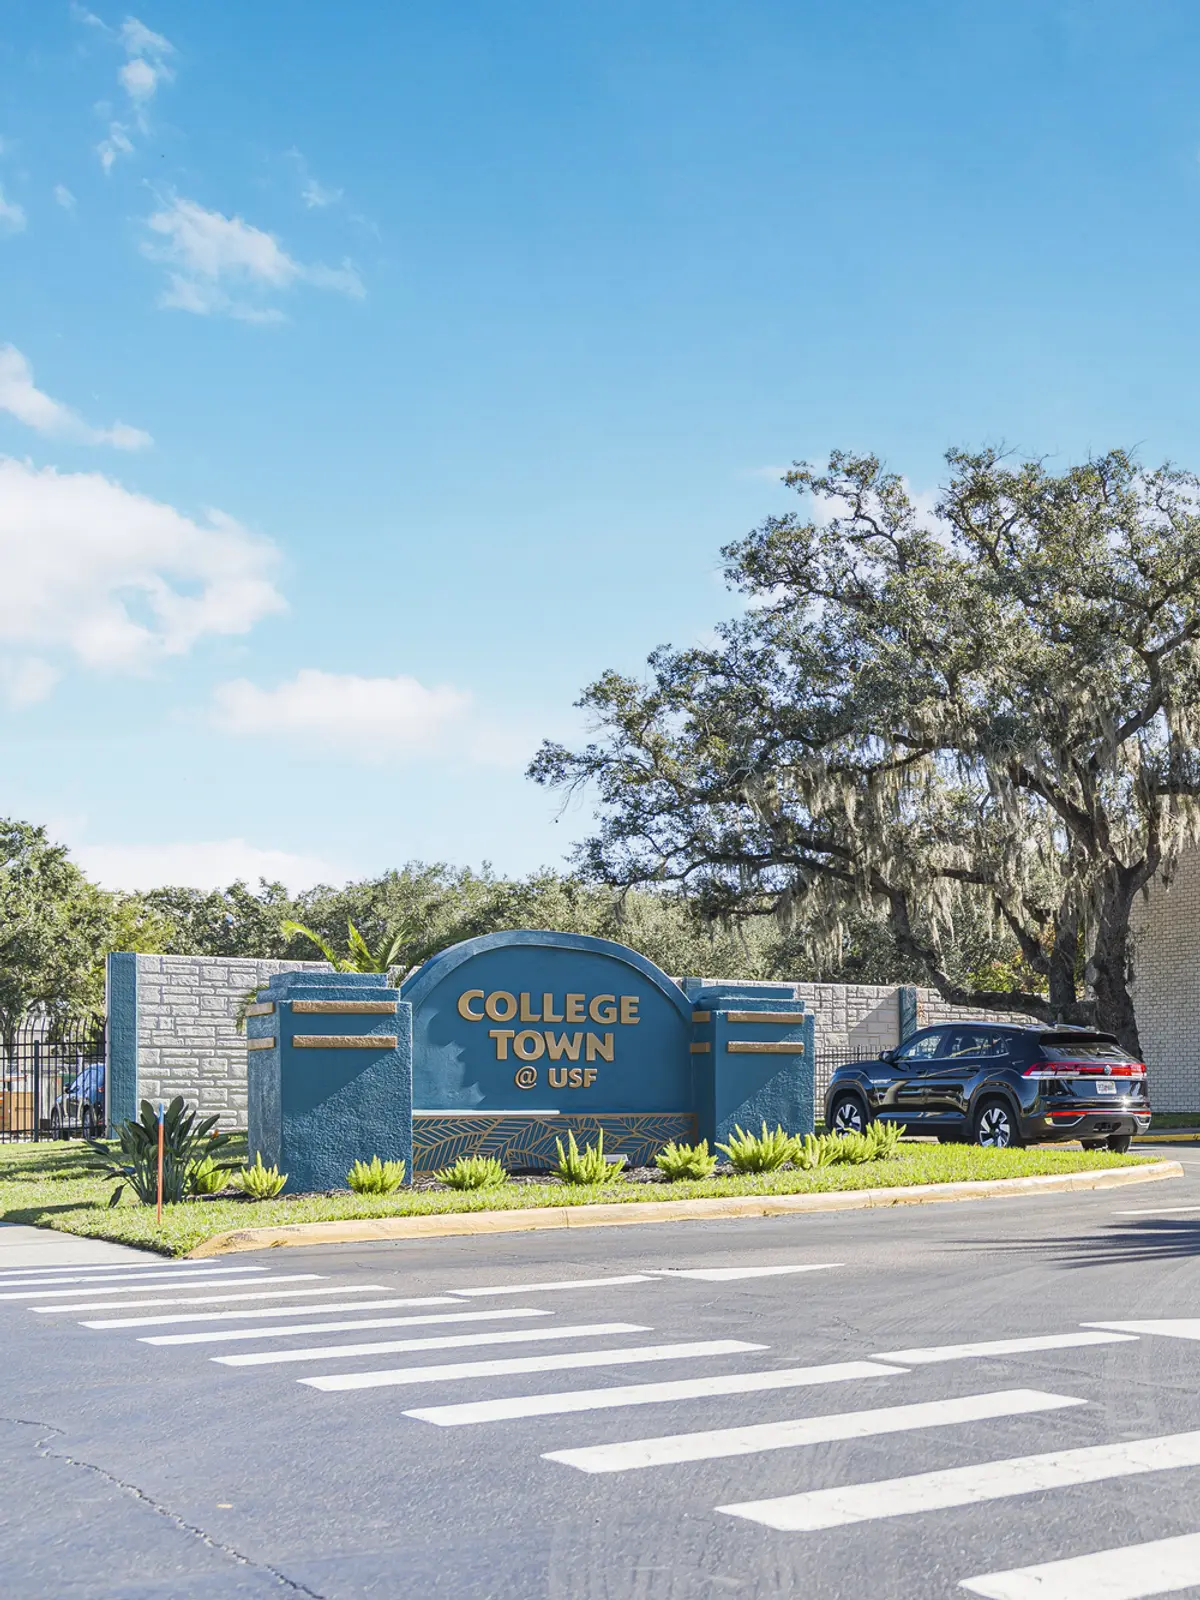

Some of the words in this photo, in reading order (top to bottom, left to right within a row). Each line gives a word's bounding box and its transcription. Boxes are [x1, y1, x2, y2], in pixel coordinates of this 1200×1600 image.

[458, 989, 641, 1024] COLLEGE
[489, 1029, 614, 1062] TOWN
[514, 1065, 538, 1089] @
[548, 1067, 598, 1088] USF
